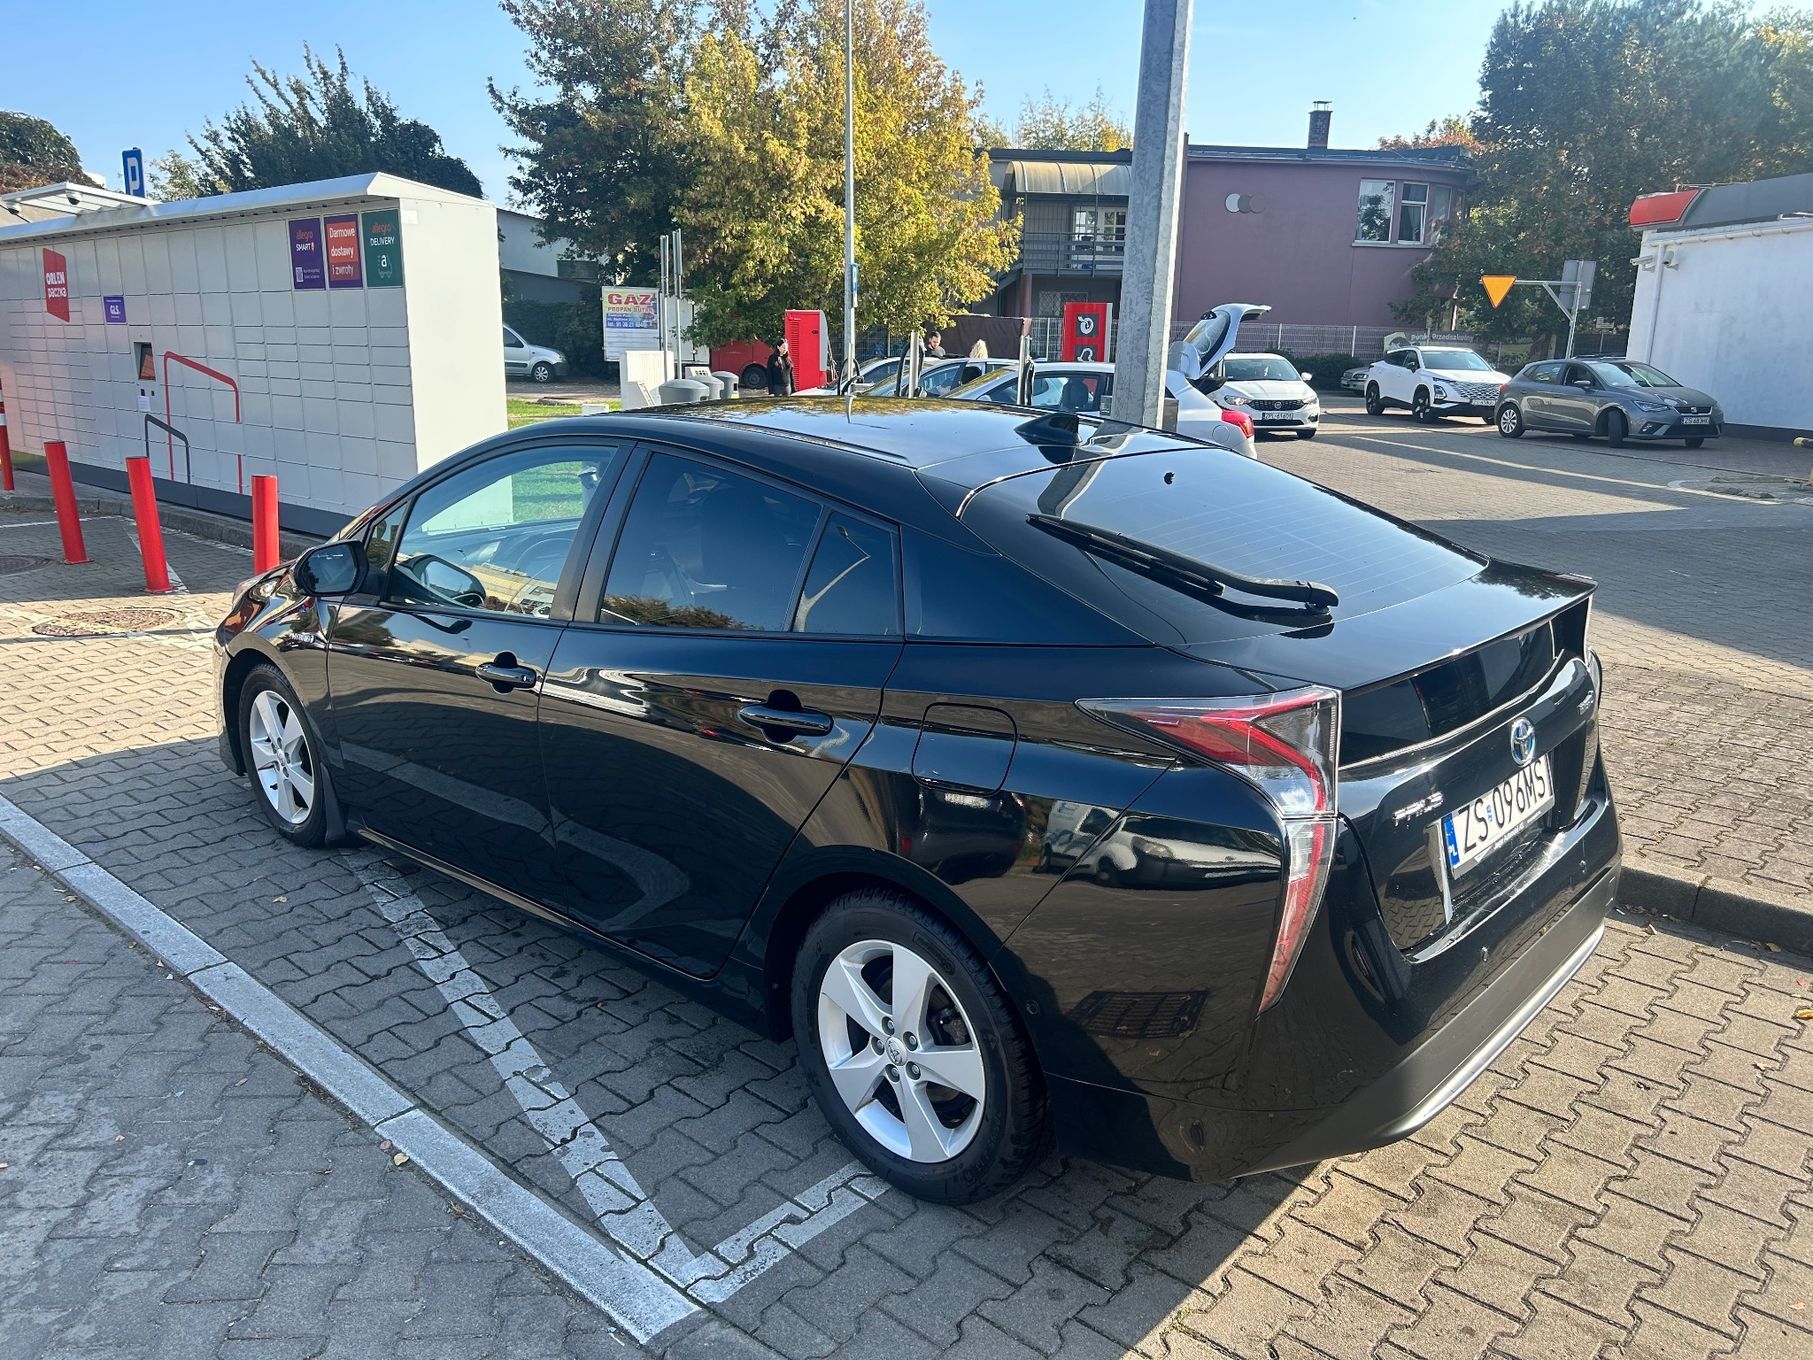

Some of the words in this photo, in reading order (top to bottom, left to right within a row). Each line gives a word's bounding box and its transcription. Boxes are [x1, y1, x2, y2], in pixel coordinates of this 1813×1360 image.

[126, 157, 140, 195] P
[329, 227, 356, 238] Darmowe
[369, 237, 395, 246] DELIVERY
[330, 246, 354, 258] dostawy
[335, 264, 354, 276] zwroty
[45, 272, 66, 285] ORLEN
[607, 293, 652, 305] GAZ
[1457, 798, 1489, 854] ZS
[1492, 759, 1546, 828] 096MS
